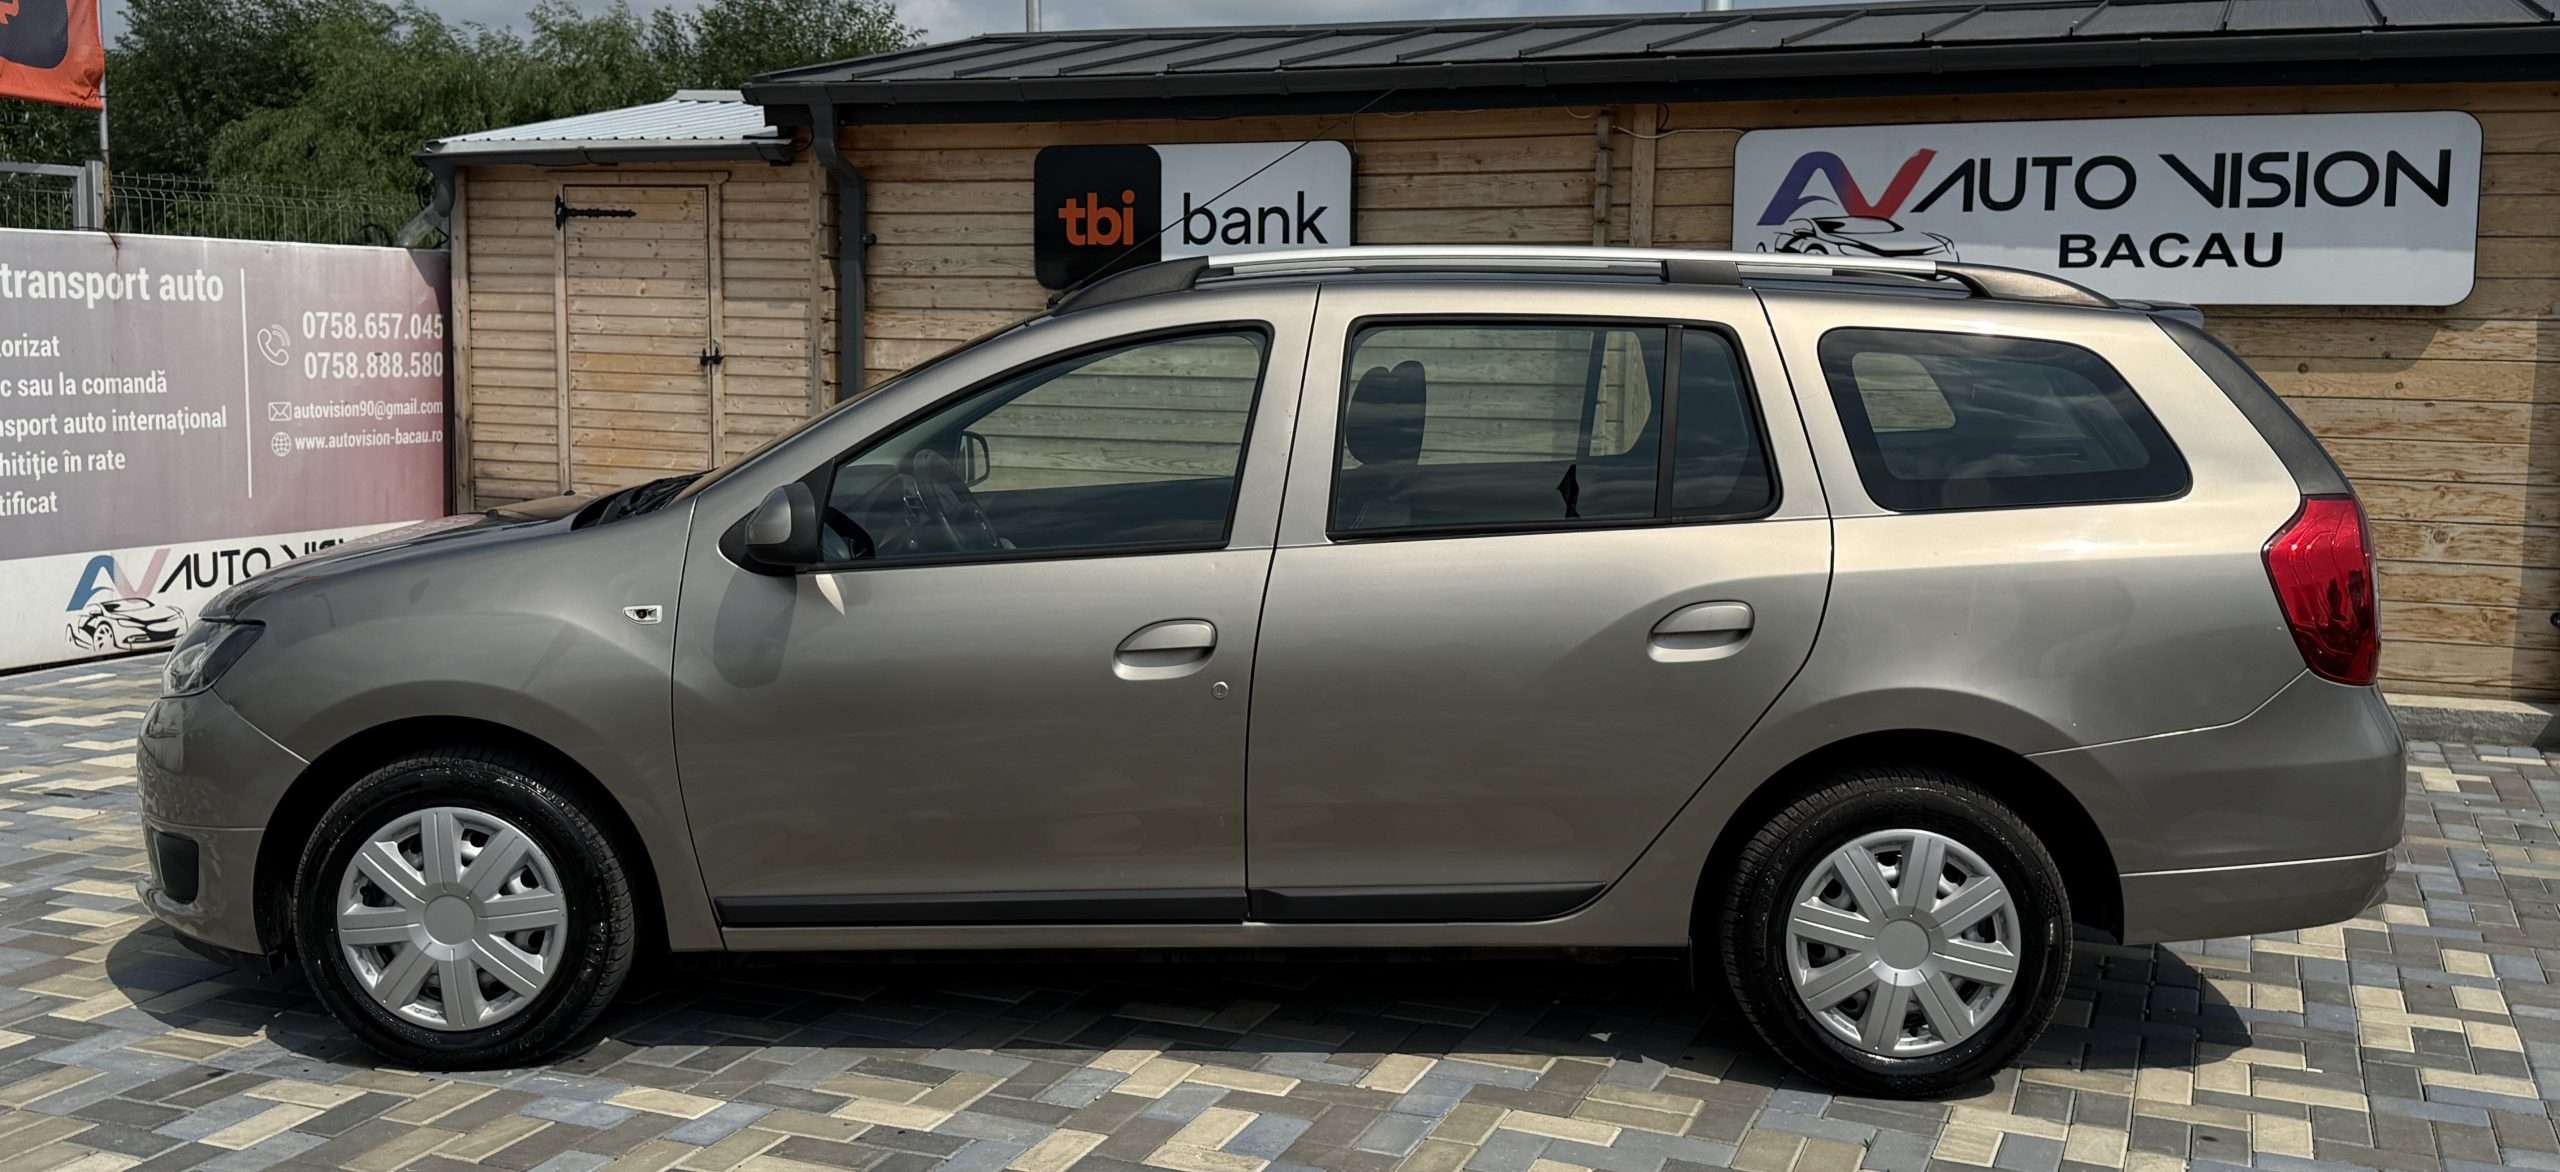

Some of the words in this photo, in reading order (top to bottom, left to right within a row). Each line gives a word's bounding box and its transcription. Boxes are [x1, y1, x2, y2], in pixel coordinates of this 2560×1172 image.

[1909, 155, 2137, 213] AUTO
[2158, 149, 2452, 209] VISION
[1058, 189, 1136, 246] tbi
[1183, 190, 1329, 245] bank
[2058, 231, 2284, 269] BACAU
[0, 263, 151, 309] transport
[159, 268, 224, 302] auto
[302, 311, 443, 340] 0758.657.045
[0, 332, 61, 358] orizat
[304, 351, 443, 379] 0758.888.580
[17, 378, 53, 397] sau
[59, 371, 77, 396] la
[82, 369, 168, 395] comandă
[293, 397, 443, 421] autovision90@gmail.com
[63, 412, 106, 435] auto
[294, 427, 443, 450] www.autovision-bacau.ro
[62, 449, 82, 473] în
[87, 449, 126, 472] rate
